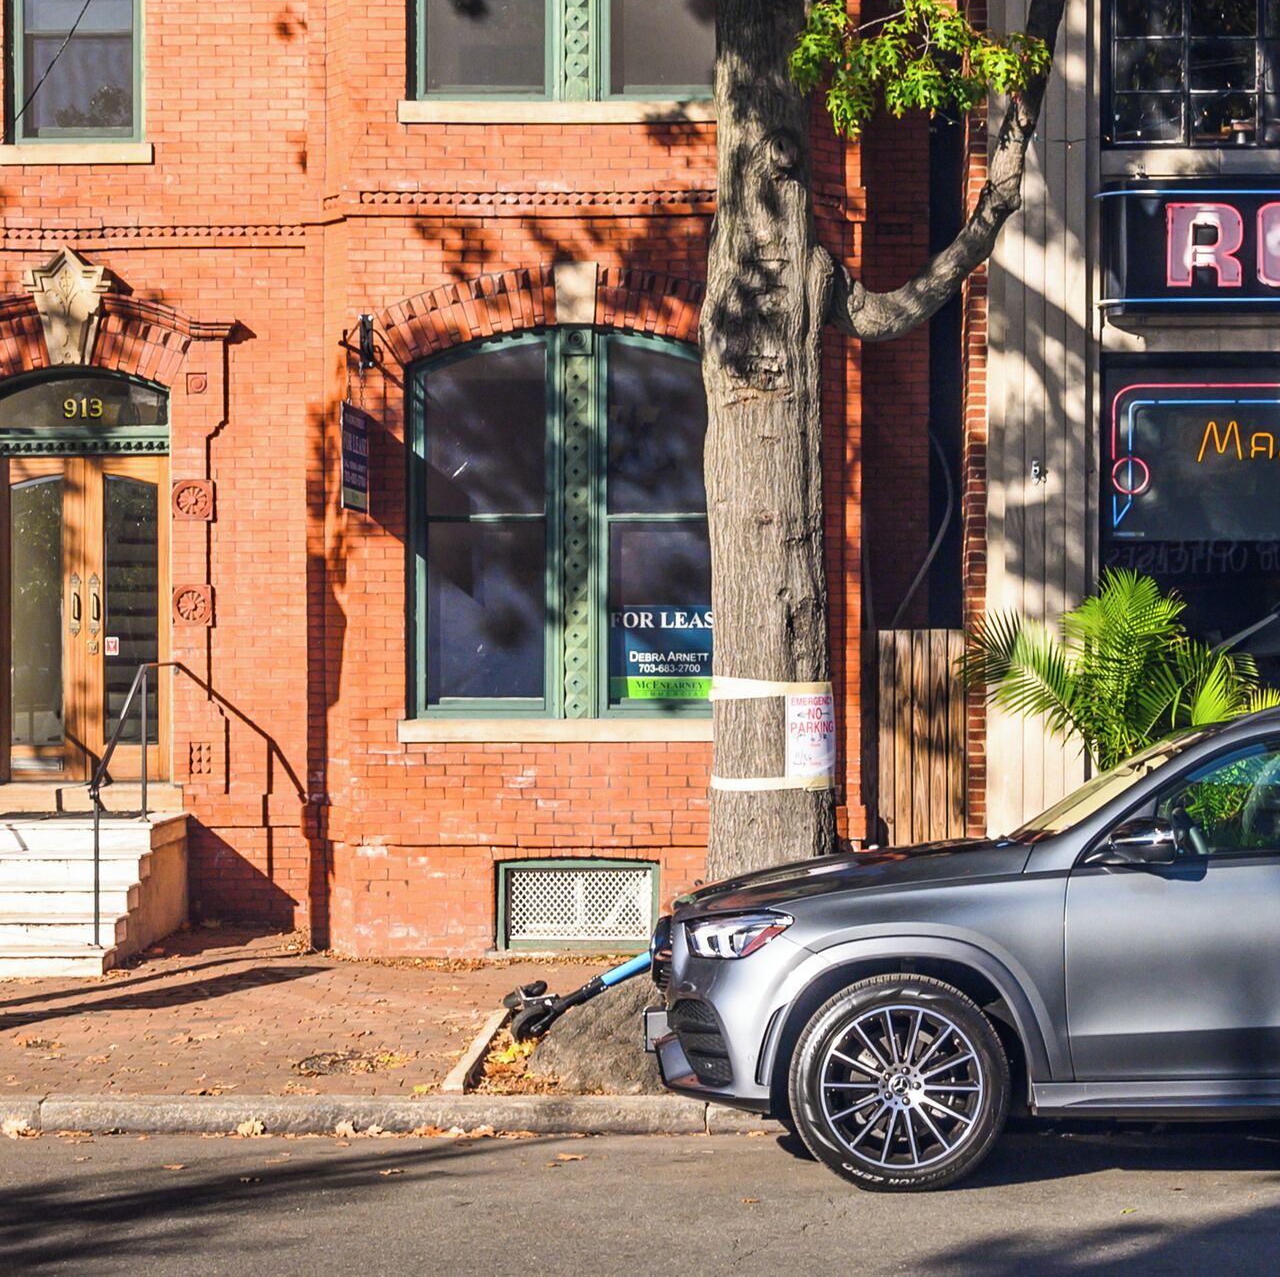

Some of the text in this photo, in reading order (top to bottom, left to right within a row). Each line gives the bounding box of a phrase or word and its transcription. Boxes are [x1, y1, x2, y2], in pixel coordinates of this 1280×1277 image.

[63, 397, 103, 418] 913
[610, 611, 714, 628] FOR LEAS
[629, 651, 709, 662] DEBRA ARNETT
[638, 663, 700, 673] 703-683-2700
[808, 707, 823, 720] NO
[790, 721, 834, 733] PARKING
